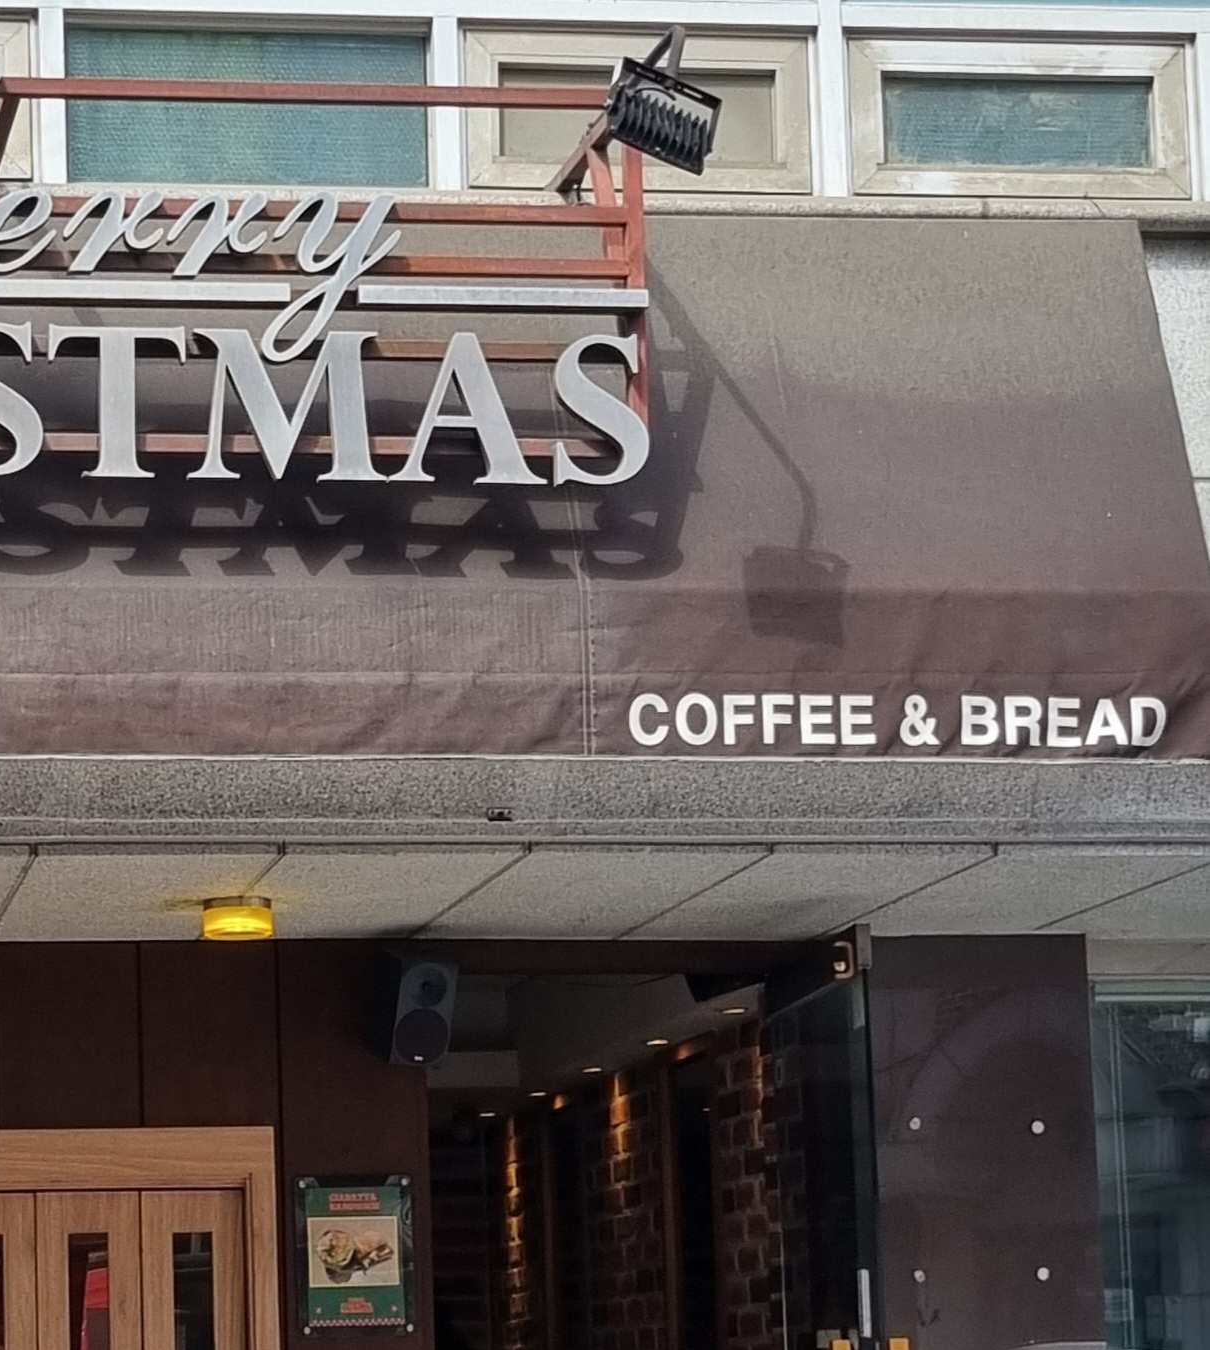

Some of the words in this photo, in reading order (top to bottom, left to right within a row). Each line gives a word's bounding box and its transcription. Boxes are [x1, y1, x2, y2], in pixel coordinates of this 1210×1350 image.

[628, 693, 877, 746] COFFEE
[899, 694, 941, 747] &
[959, 695, 1168, 748] BREAD
